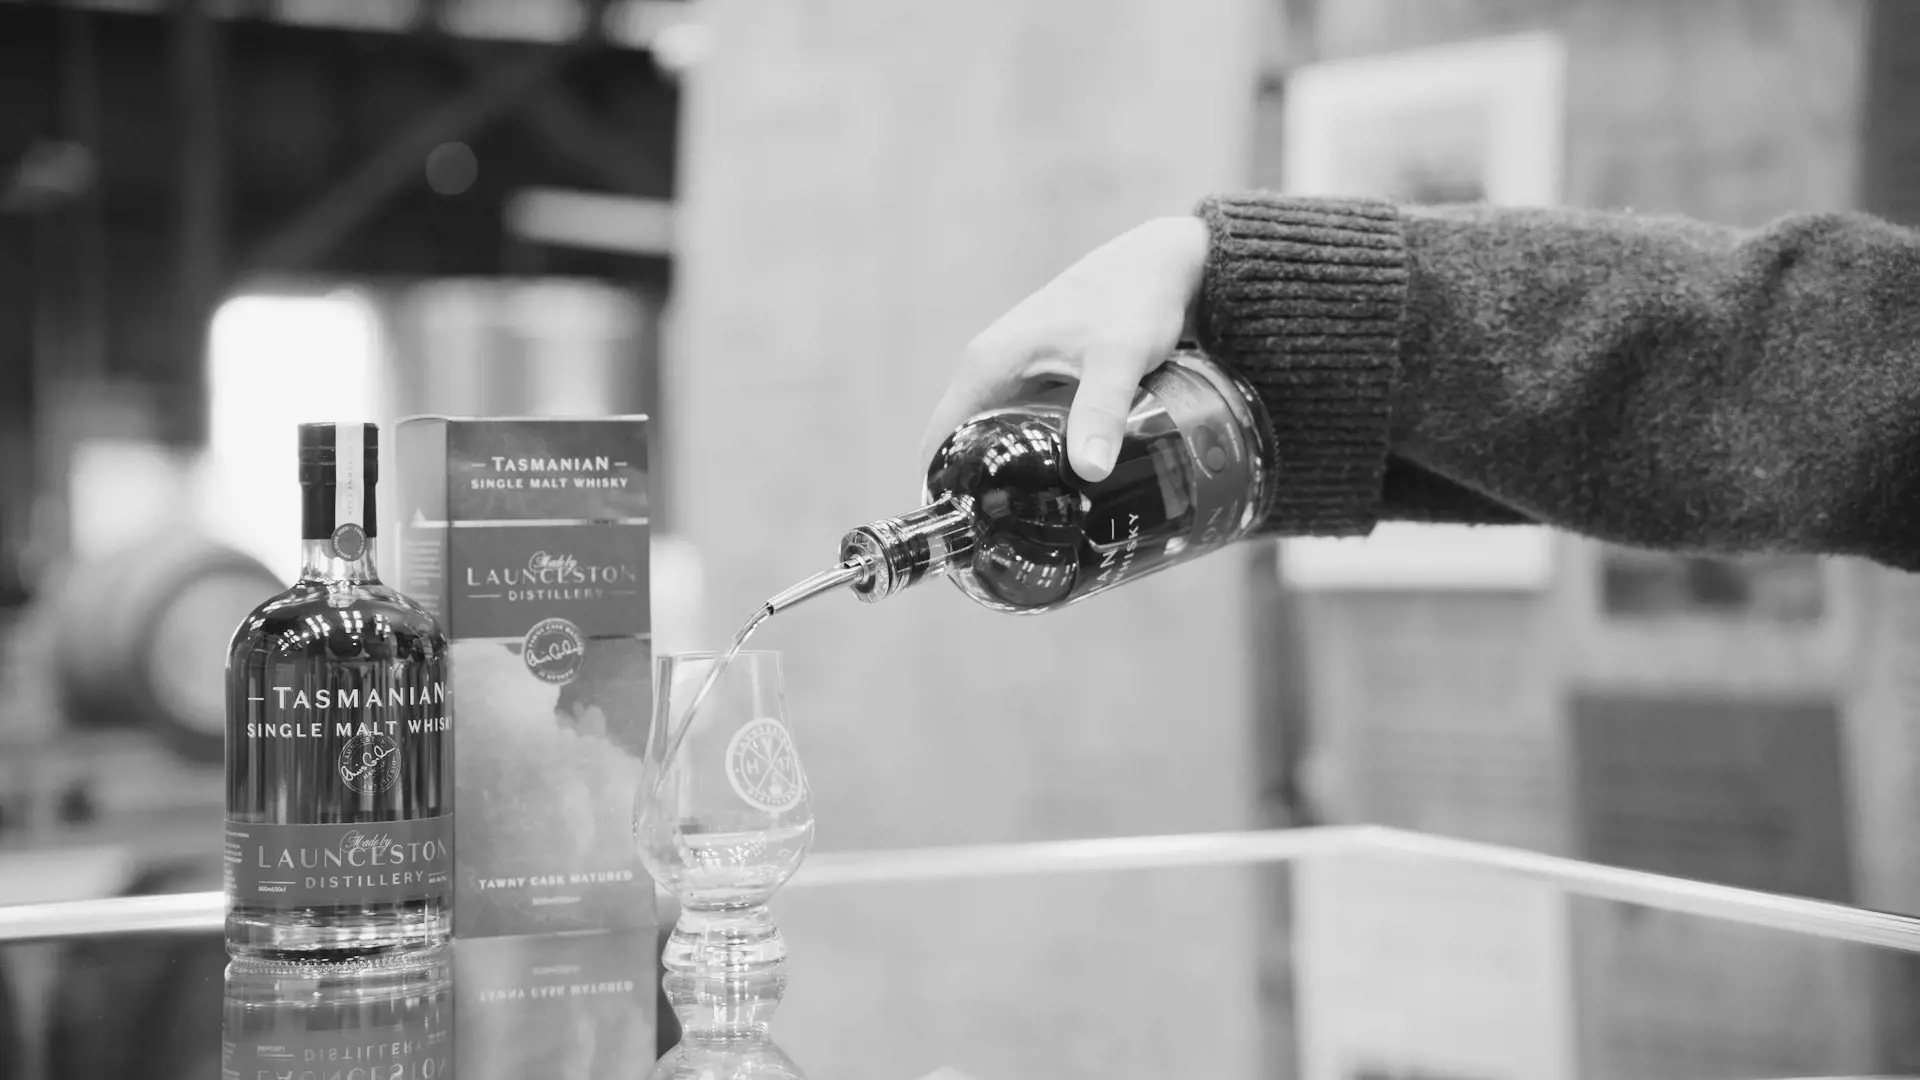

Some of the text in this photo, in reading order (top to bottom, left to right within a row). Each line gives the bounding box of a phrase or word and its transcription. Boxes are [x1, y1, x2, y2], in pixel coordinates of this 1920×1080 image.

[491, 456, 609, 472] TASMANIAN
[471, 477, 628, 489] SINGLE MALT WHISKY
[467, 564, 636, 586] LAUNCESTON
[508, 588, 603, 601] DISTILLERY
[273, 682, 445, 710] TASMANIAN
[247, 716, 452, 738] SINGLE MALT WHISK
[258, 838, 448, 868] LAUNCESTON
[340, 830, 392, 855] Made by
[306, 870, 424, 889] DISTILLERY
[479, 870, 634, 890] TAWNY CASK MATURED
